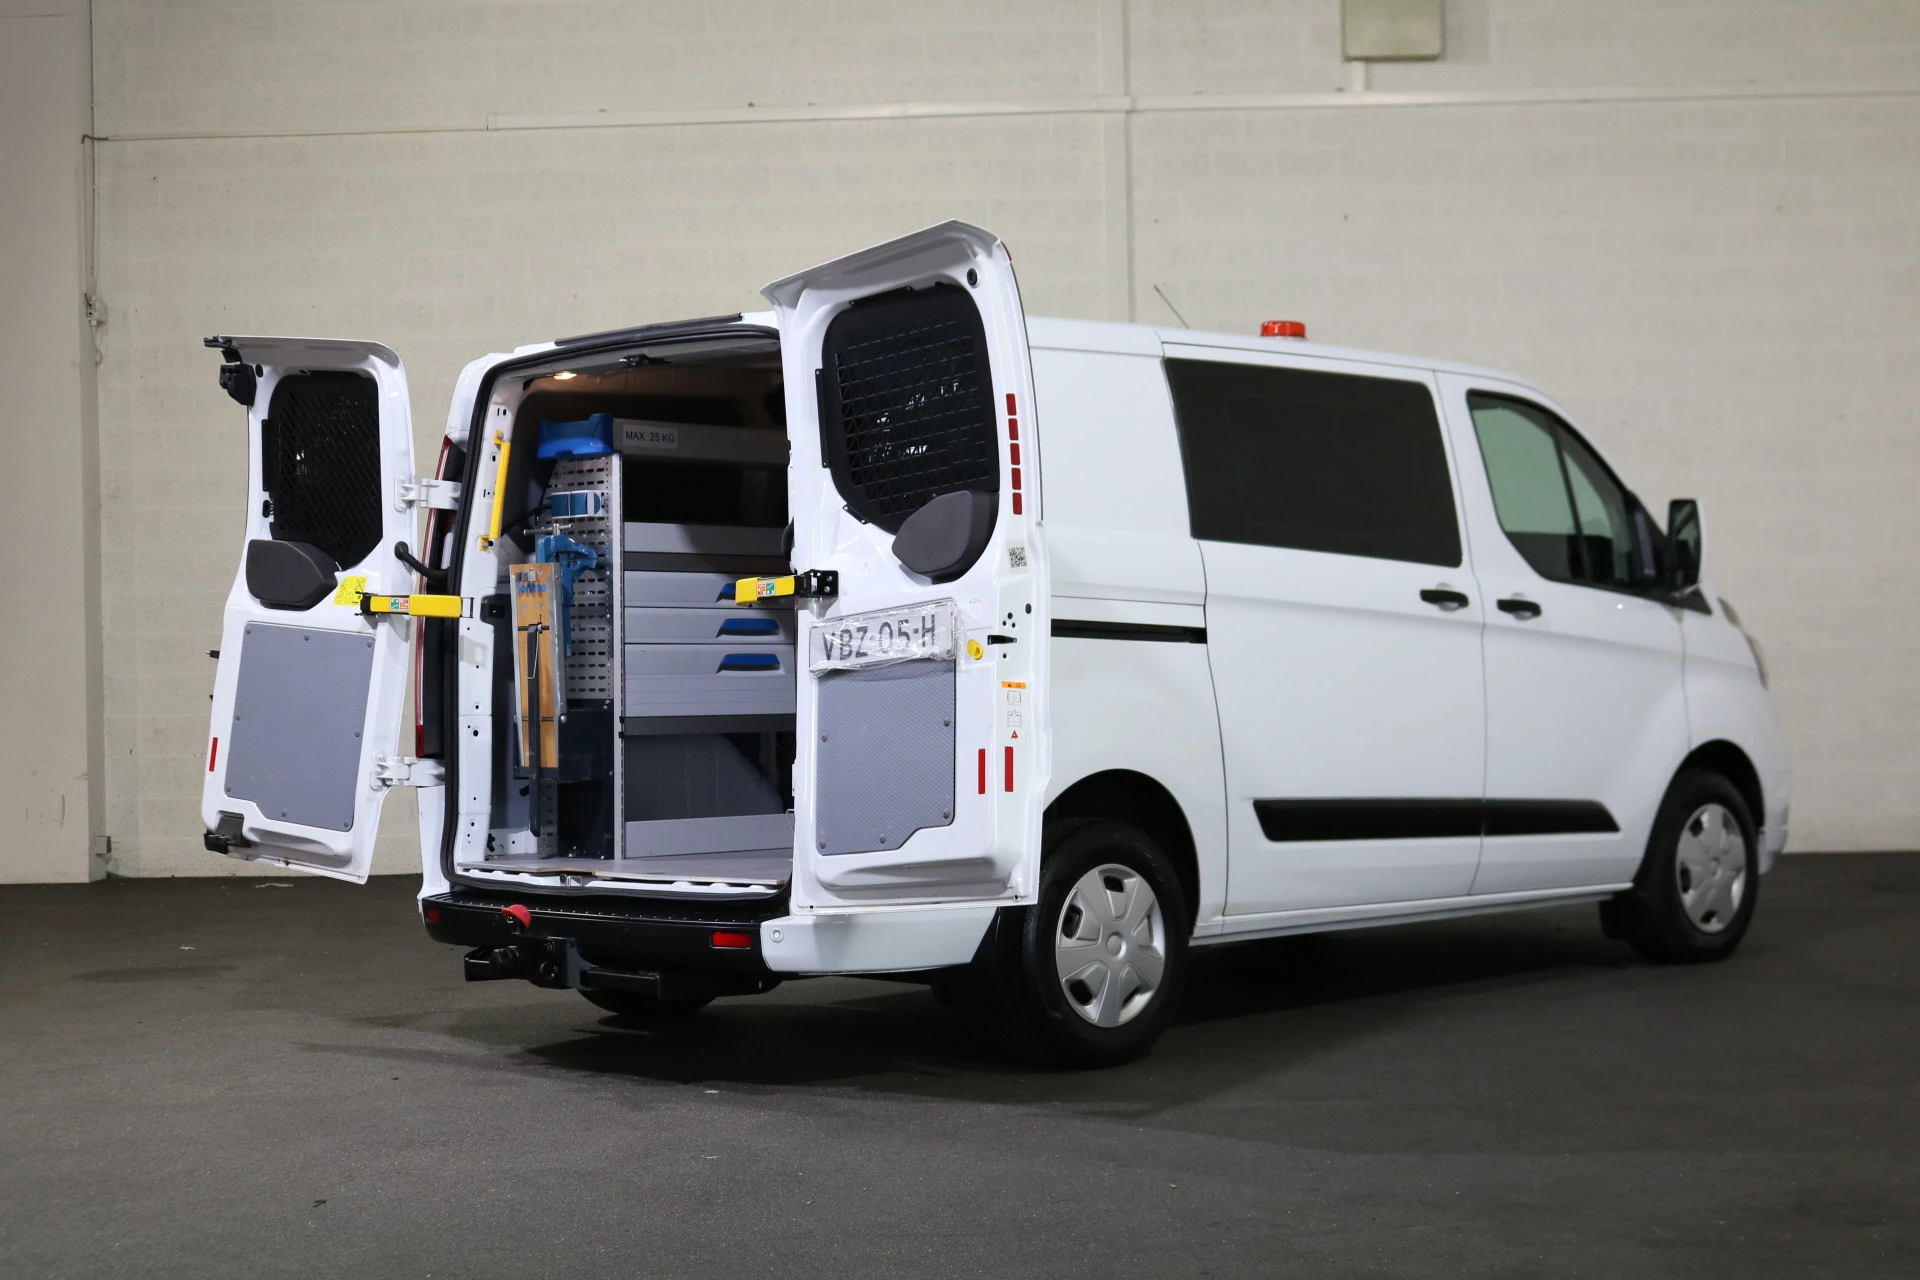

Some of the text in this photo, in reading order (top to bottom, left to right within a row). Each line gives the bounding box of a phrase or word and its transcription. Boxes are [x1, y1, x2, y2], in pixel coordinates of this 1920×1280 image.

[625, 430, 675, 444] MAX. 25 KG
